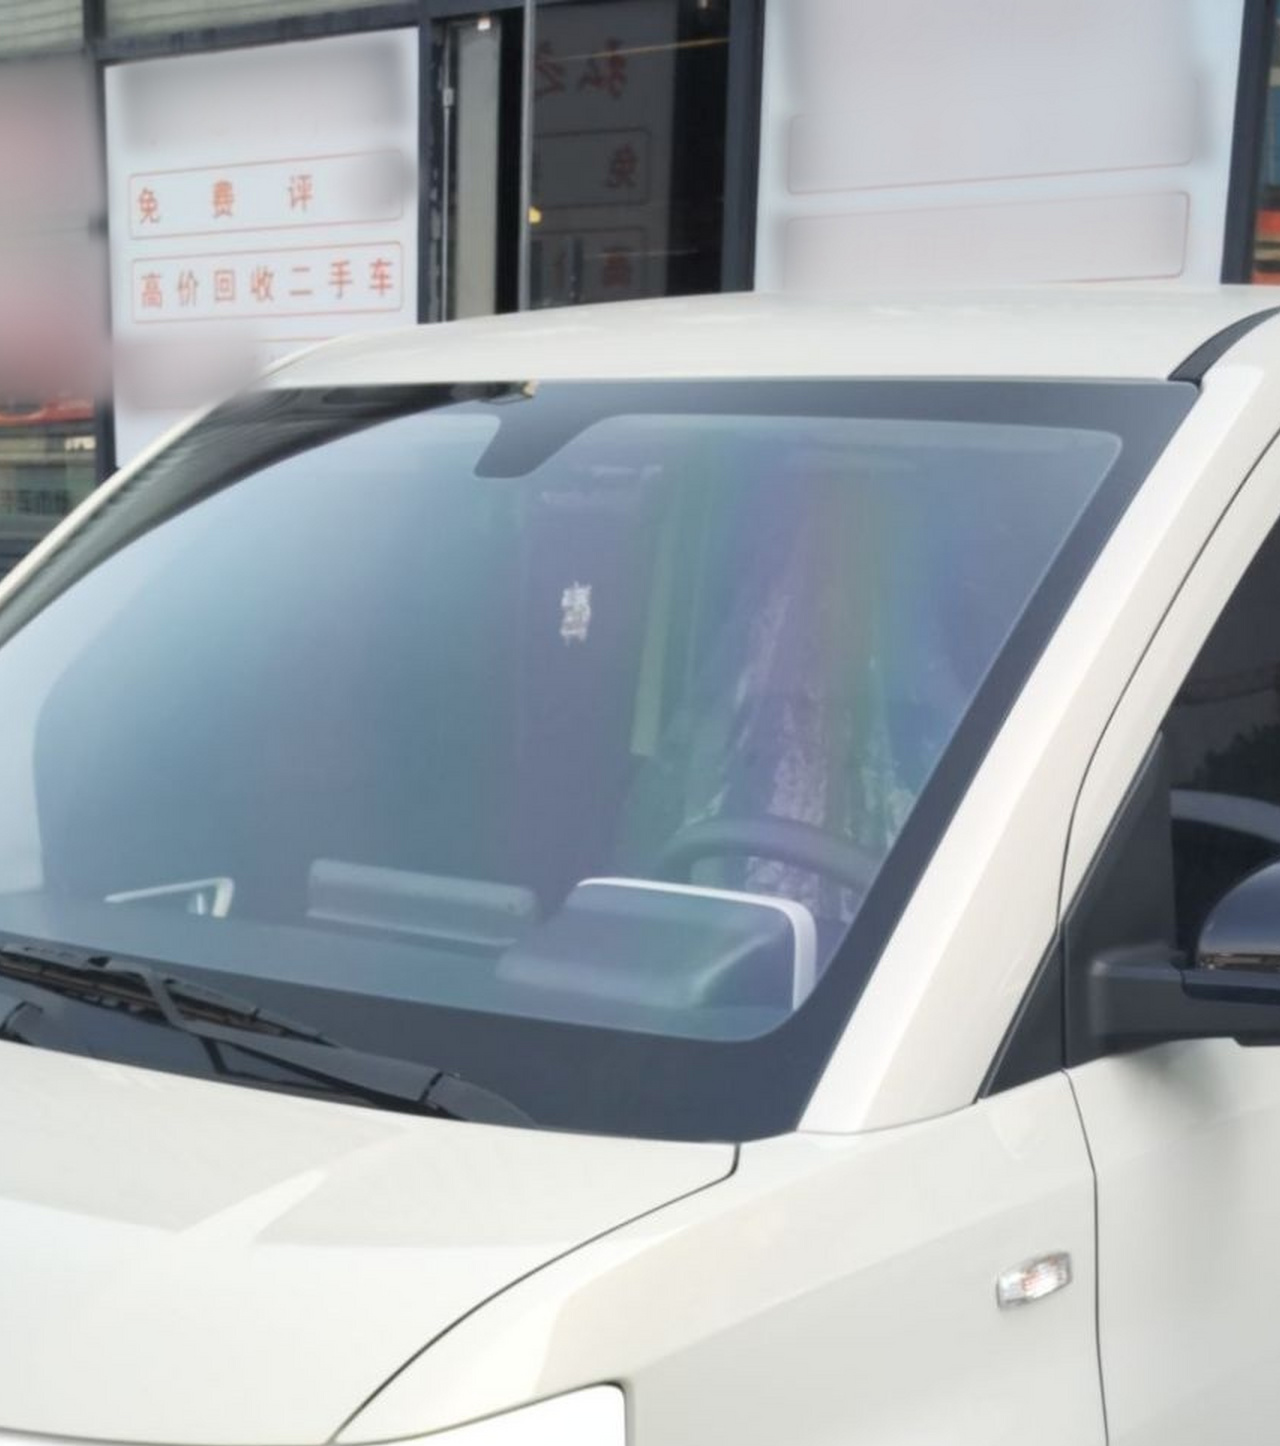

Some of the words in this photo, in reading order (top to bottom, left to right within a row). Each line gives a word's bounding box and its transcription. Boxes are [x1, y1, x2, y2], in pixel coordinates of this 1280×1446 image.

[138, 172, 388, 225] 免费评
[140, 257, 394, 309] 高价回收二手车
